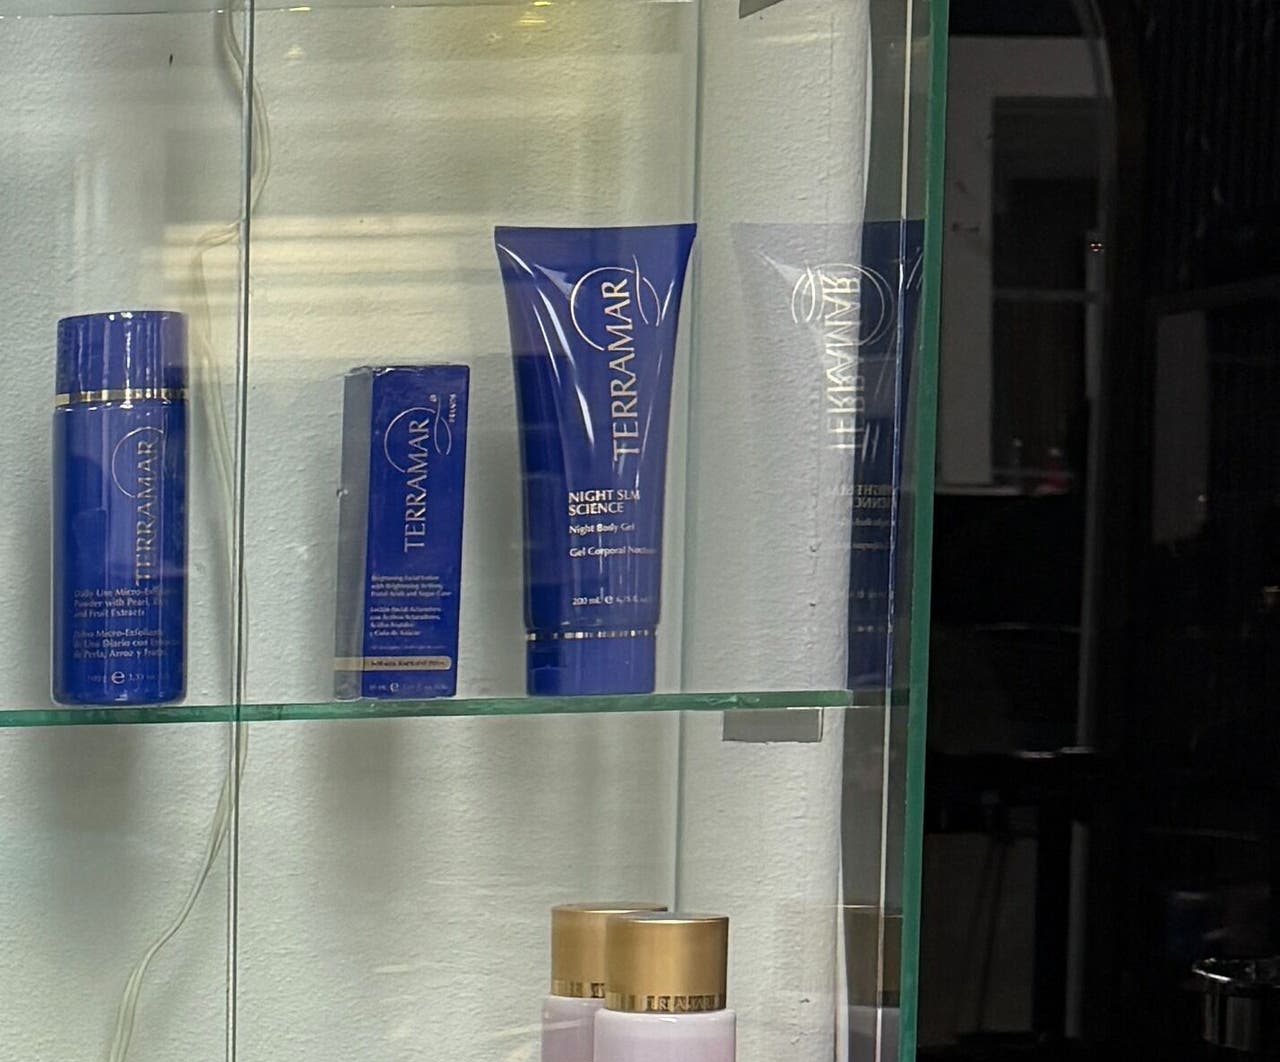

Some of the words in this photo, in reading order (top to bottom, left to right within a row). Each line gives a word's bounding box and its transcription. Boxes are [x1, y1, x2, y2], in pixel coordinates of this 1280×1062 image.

[602, 277, 640, 462] TERRAMAR
[404, 418, 430, 553] TERRAMAR
[569, 489, 614, 503] NIGHT
[135, 438, 155, 584] TERRAMAR
[568, 502, 624, 517] SCIENCE
[569, 524, 594, 536] Night
[597, 523, 618, 534] Body
[621, 523, 635, 531] Gel
[570, 547, 586, 557] Gel
[588, 546, 626, 557] Corporal
